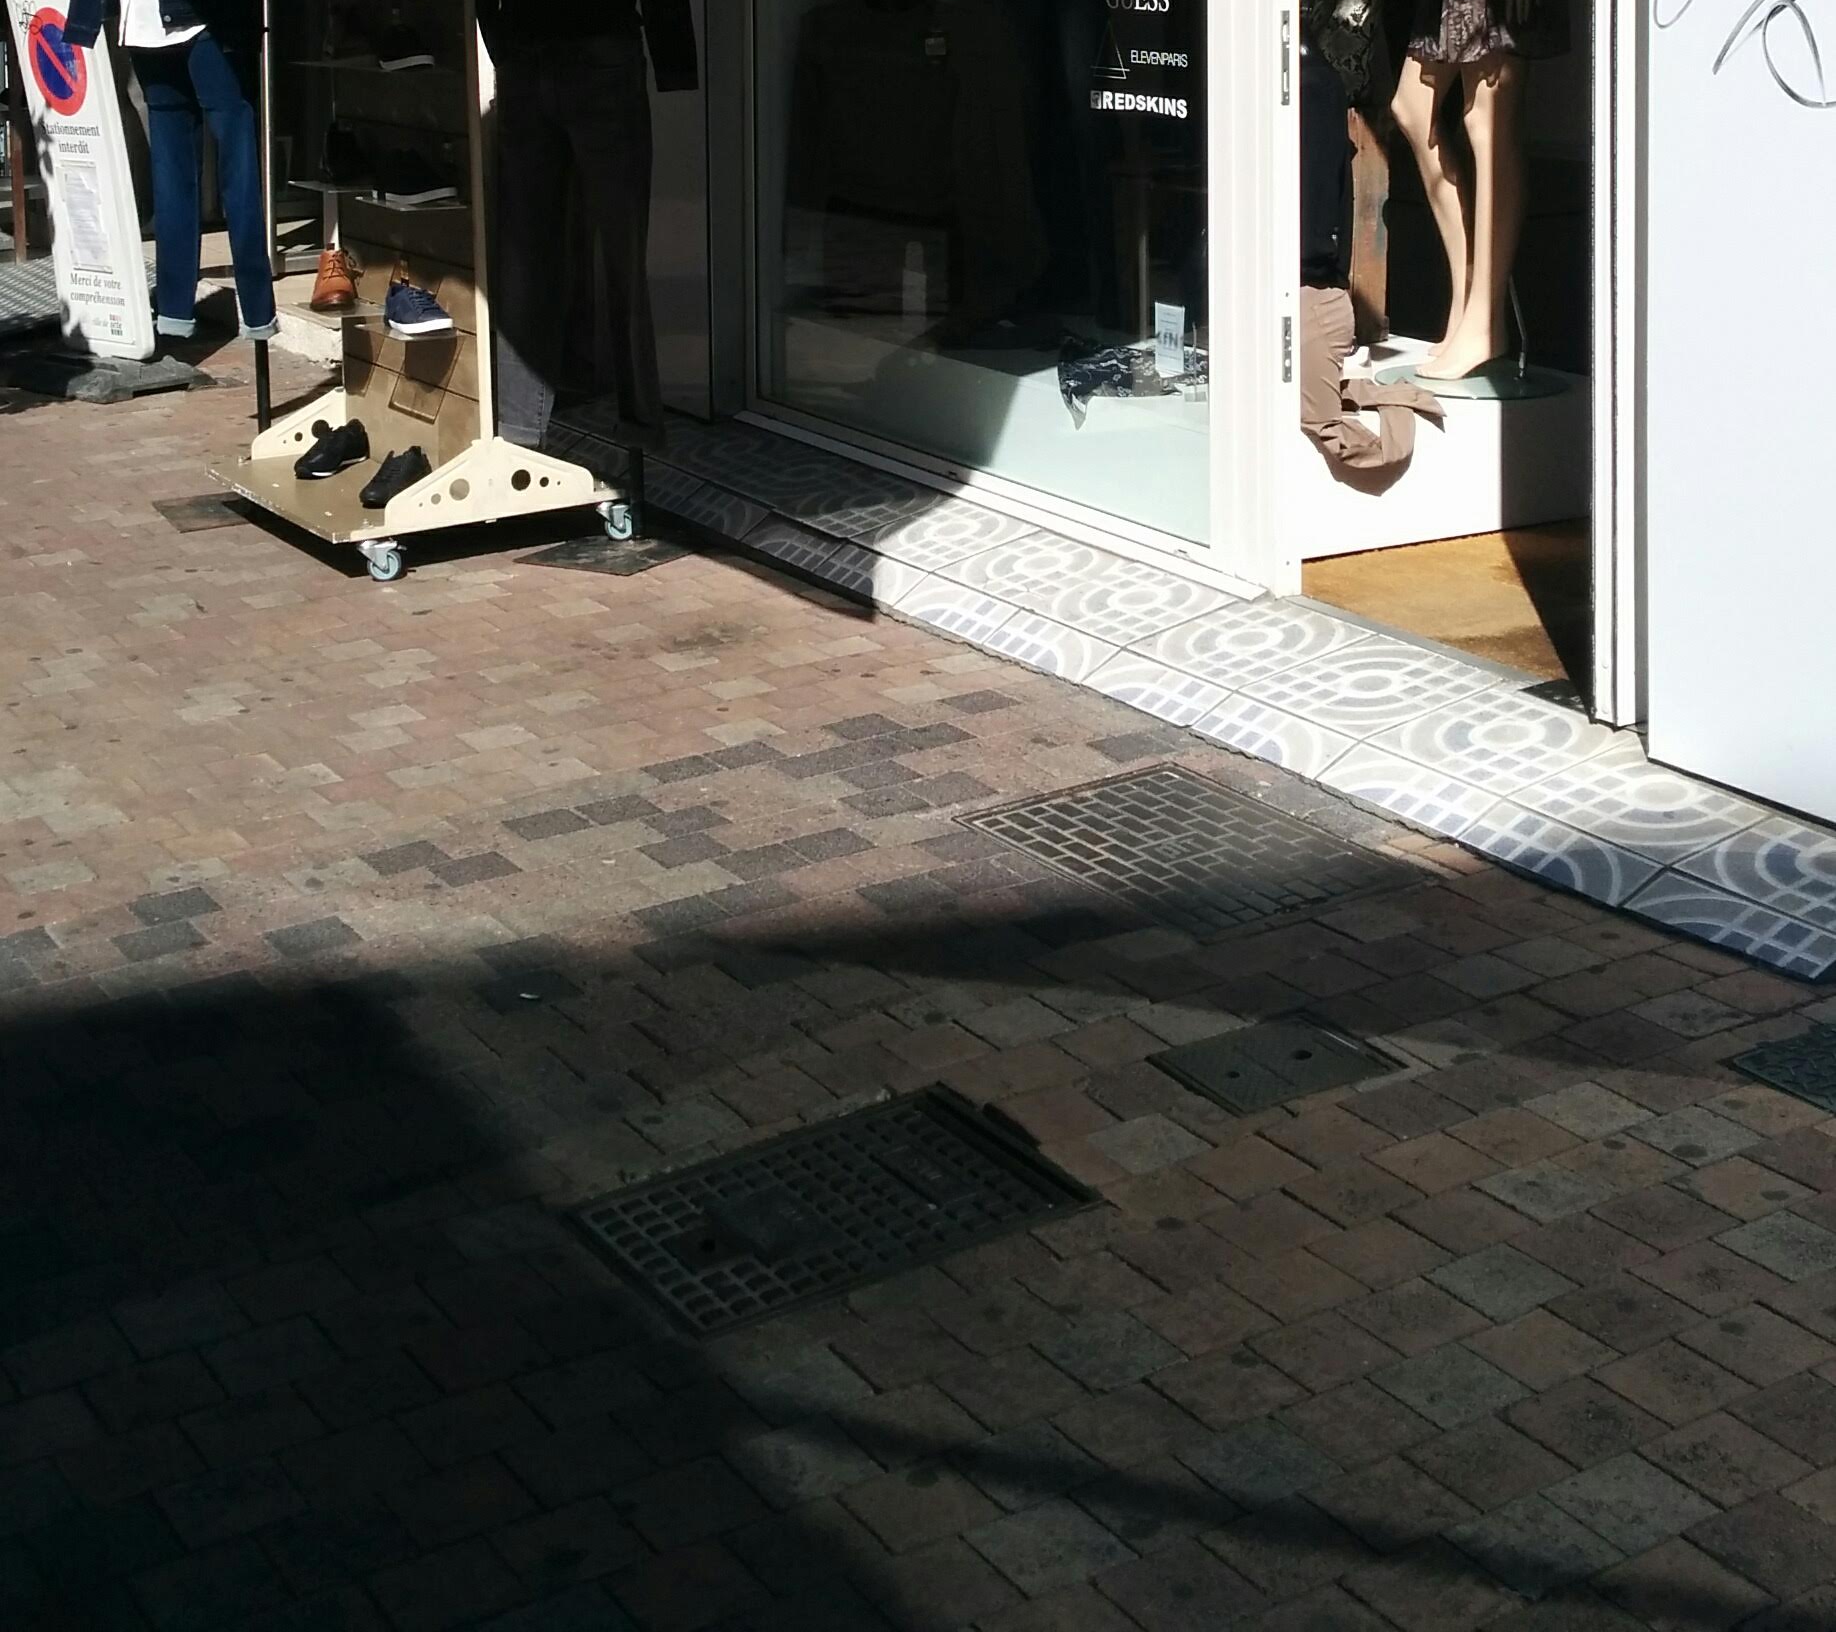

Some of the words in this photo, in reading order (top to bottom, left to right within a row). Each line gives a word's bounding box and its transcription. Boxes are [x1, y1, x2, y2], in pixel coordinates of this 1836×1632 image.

[1102, 90, 1188, 119] REDSKINS
[58, 140, 90, 154] interdit
[70, 272, 92, 287] Merci
[92, 275, 102, 288] de
[104, 279, 121, 290] votre
[70, 290, 126, 306] compréhension
